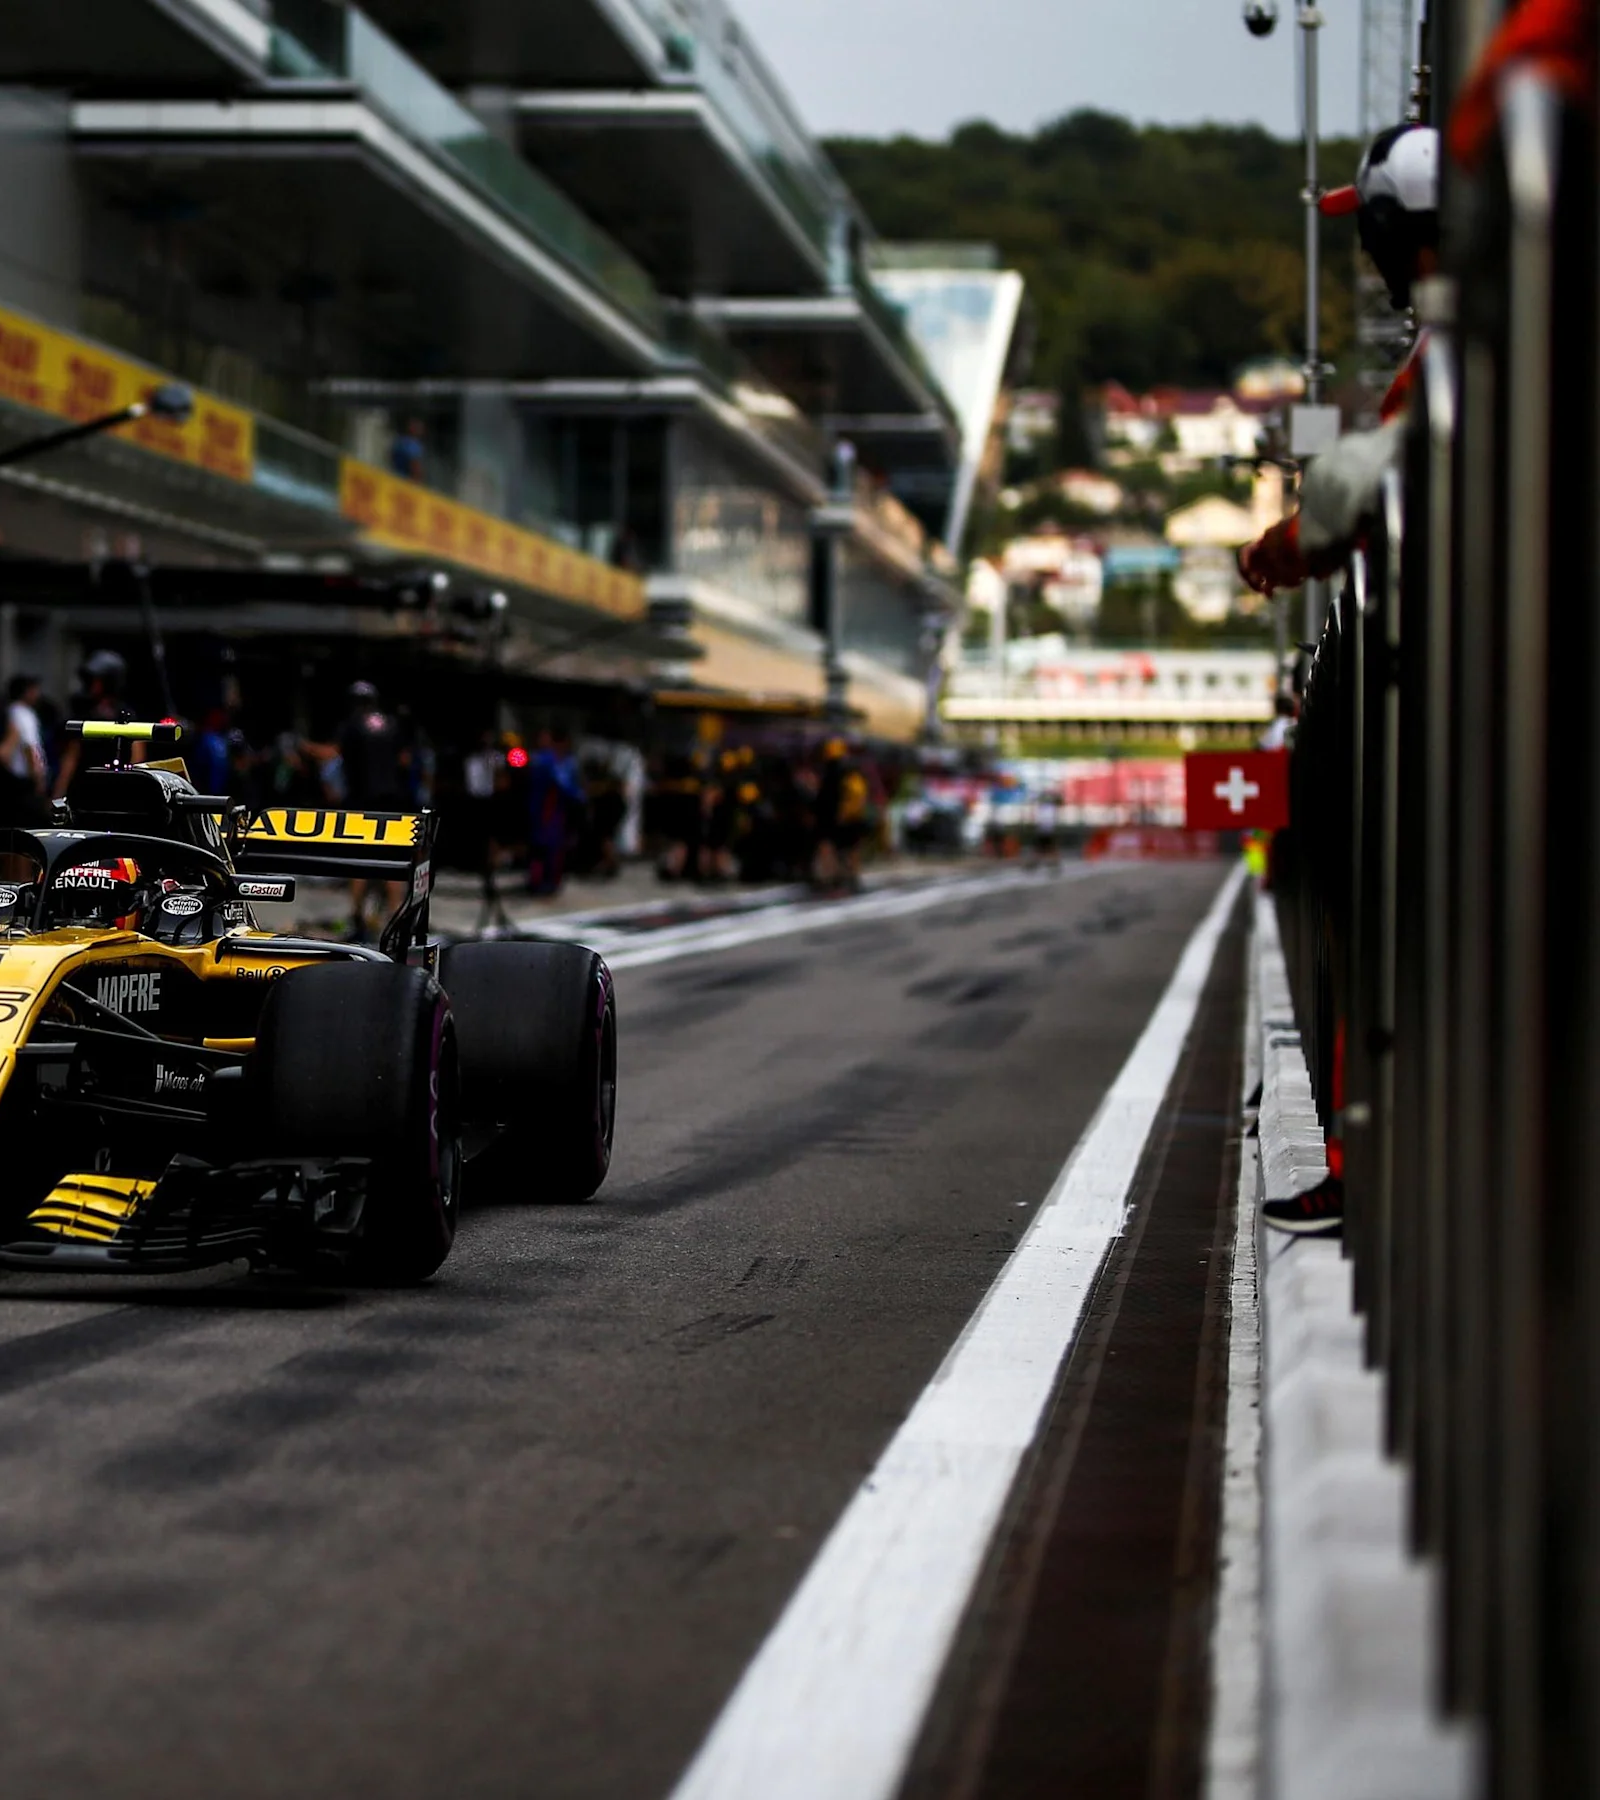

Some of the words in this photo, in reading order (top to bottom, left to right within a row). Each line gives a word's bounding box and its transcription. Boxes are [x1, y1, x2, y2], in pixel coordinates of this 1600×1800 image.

[246, 808, 402, 841] AULT
[59, 867, 112, 878] APFRE
[51, 876, 118, 890] ENAULT
[250, 885, 283, 896] Castrol
[235, 967, 263, 980] Bell
[96, 972, 162, 1014] MAPFRE
